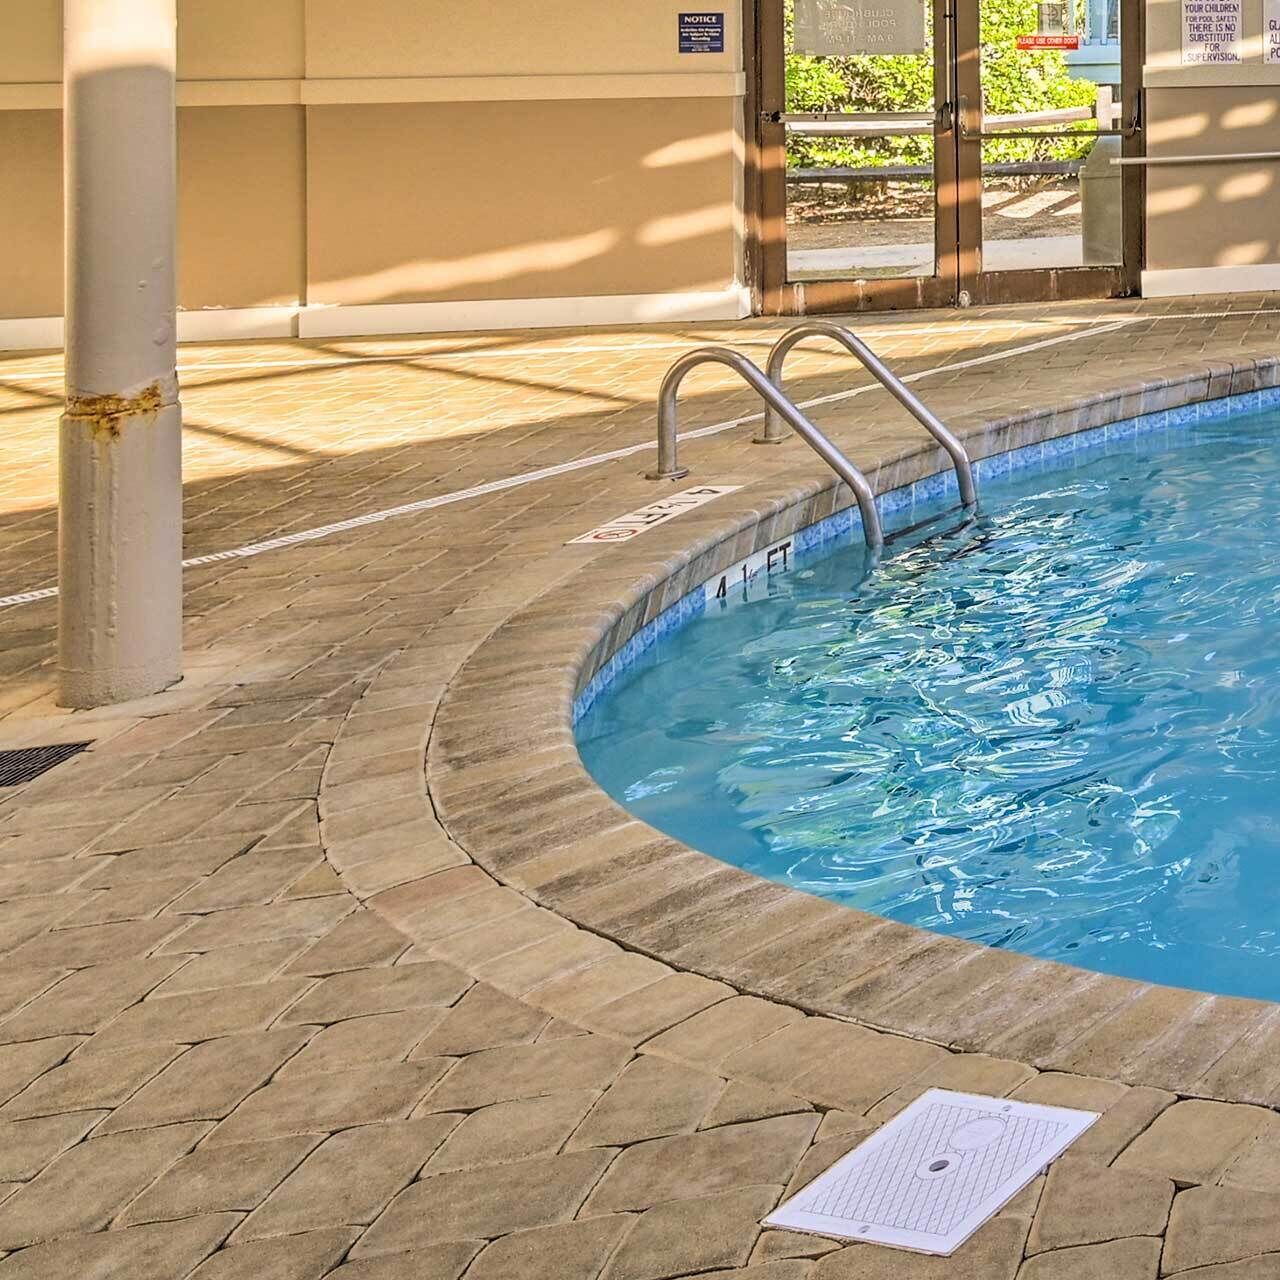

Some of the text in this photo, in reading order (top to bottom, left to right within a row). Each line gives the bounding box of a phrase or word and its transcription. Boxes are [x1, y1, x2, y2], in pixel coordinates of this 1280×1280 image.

[1184, 3, 1204, 13] YOUR
[684, 16, 717, 24] NOTICE
[1188, 23, 1236, 33] THERE IS NO
[1189, 33, 1236, 42] SUBSTITUTE
[1204, 42, 1220, 52] FOR
[767, 541, 792, 573] FT
